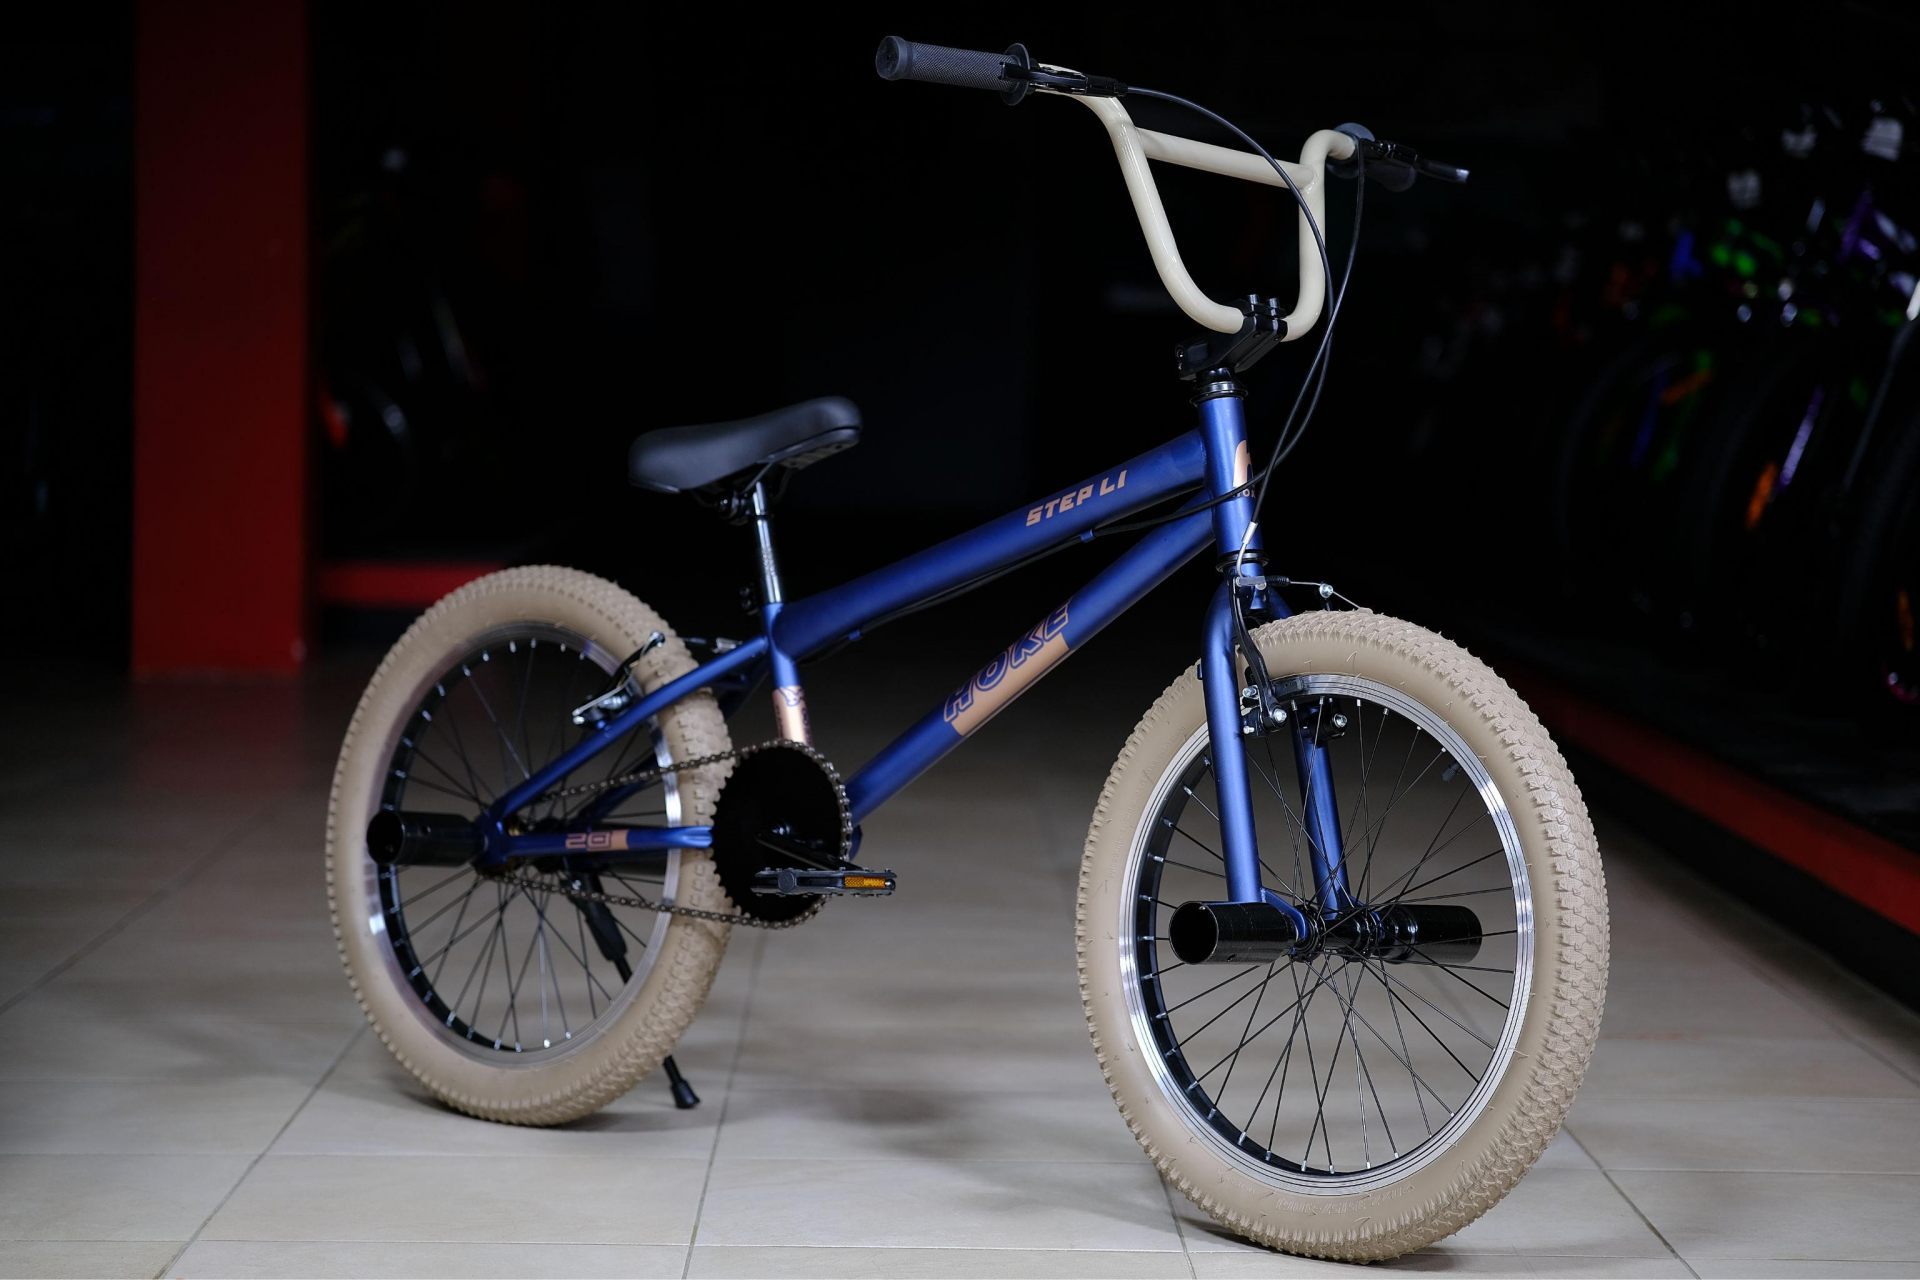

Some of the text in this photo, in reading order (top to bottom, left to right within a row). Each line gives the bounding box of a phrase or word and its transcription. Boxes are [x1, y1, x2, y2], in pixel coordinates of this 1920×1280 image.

[1025, 469, 1128, 527] STEP LI
[944, 600, 1070, 722] HOKE
[564, 831, 613, 852] 20
